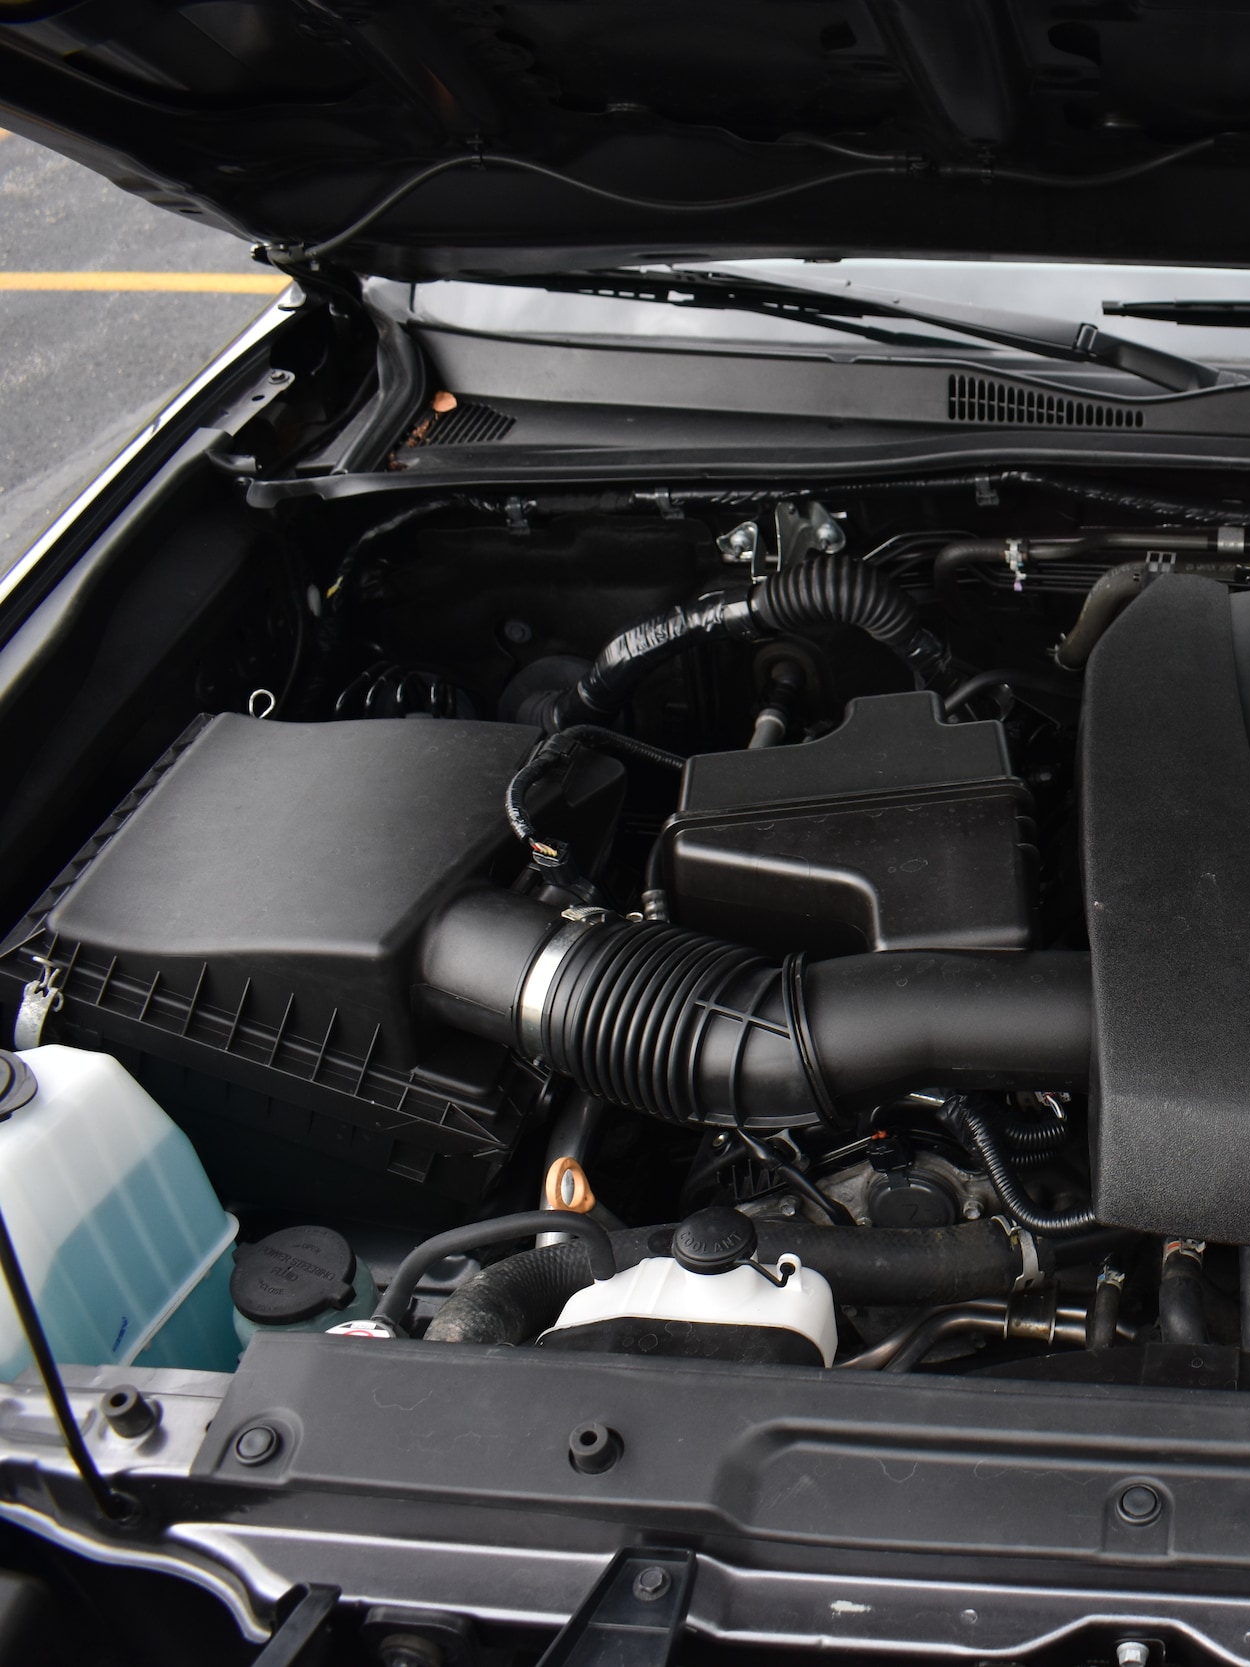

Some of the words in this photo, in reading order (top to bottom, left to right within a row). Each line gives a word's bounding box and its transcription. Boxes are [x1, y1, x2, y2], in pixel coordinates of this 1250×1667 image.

[679, 1230, 743, 1254] COOLANT
[258, 1245, 292, 1265] POWER
[290, 1257, 336, 1281] STEERING
[270, 1266, 299, 1282] FLUID
